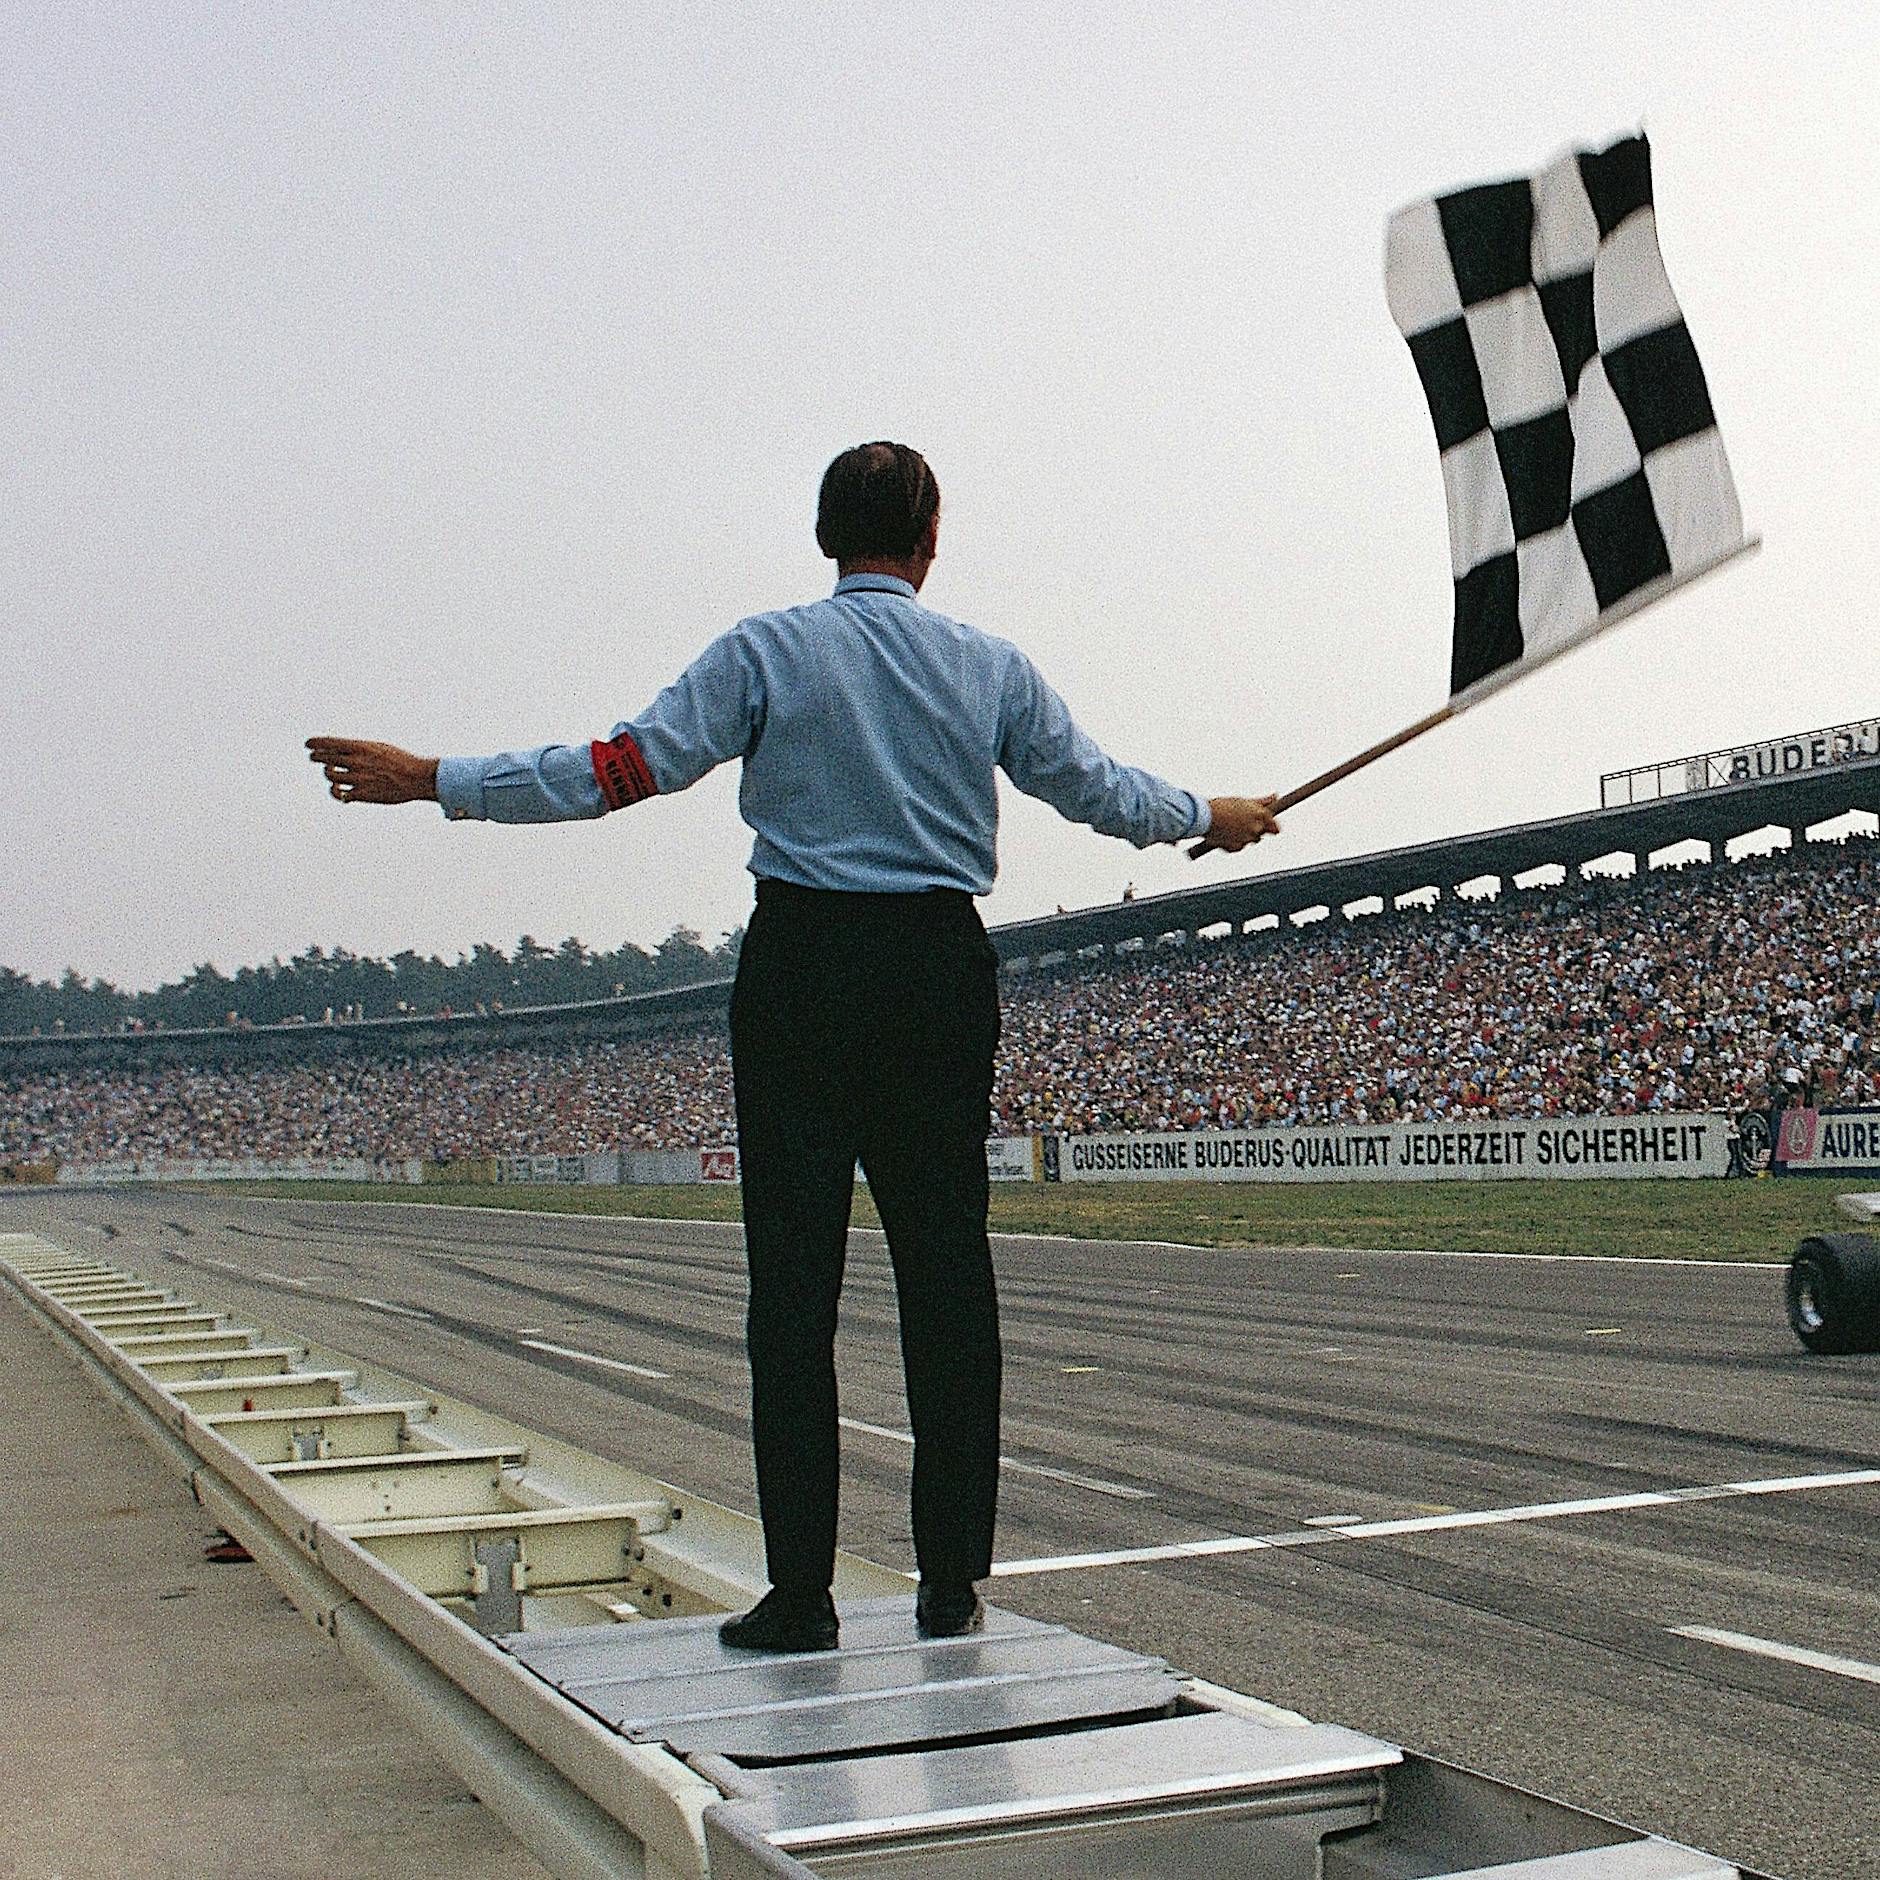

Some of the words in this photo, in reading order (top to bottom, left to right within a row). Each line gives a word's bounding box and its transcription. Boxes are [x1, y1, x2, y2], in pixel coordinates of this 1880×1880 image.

[1073, 1142, 1188, 1171] GUSSEISERNE
[1399, 1132, 1526, 1166] JEDERZEIT
[1537, 1126, 1707, 1165] SICHERHEIT
